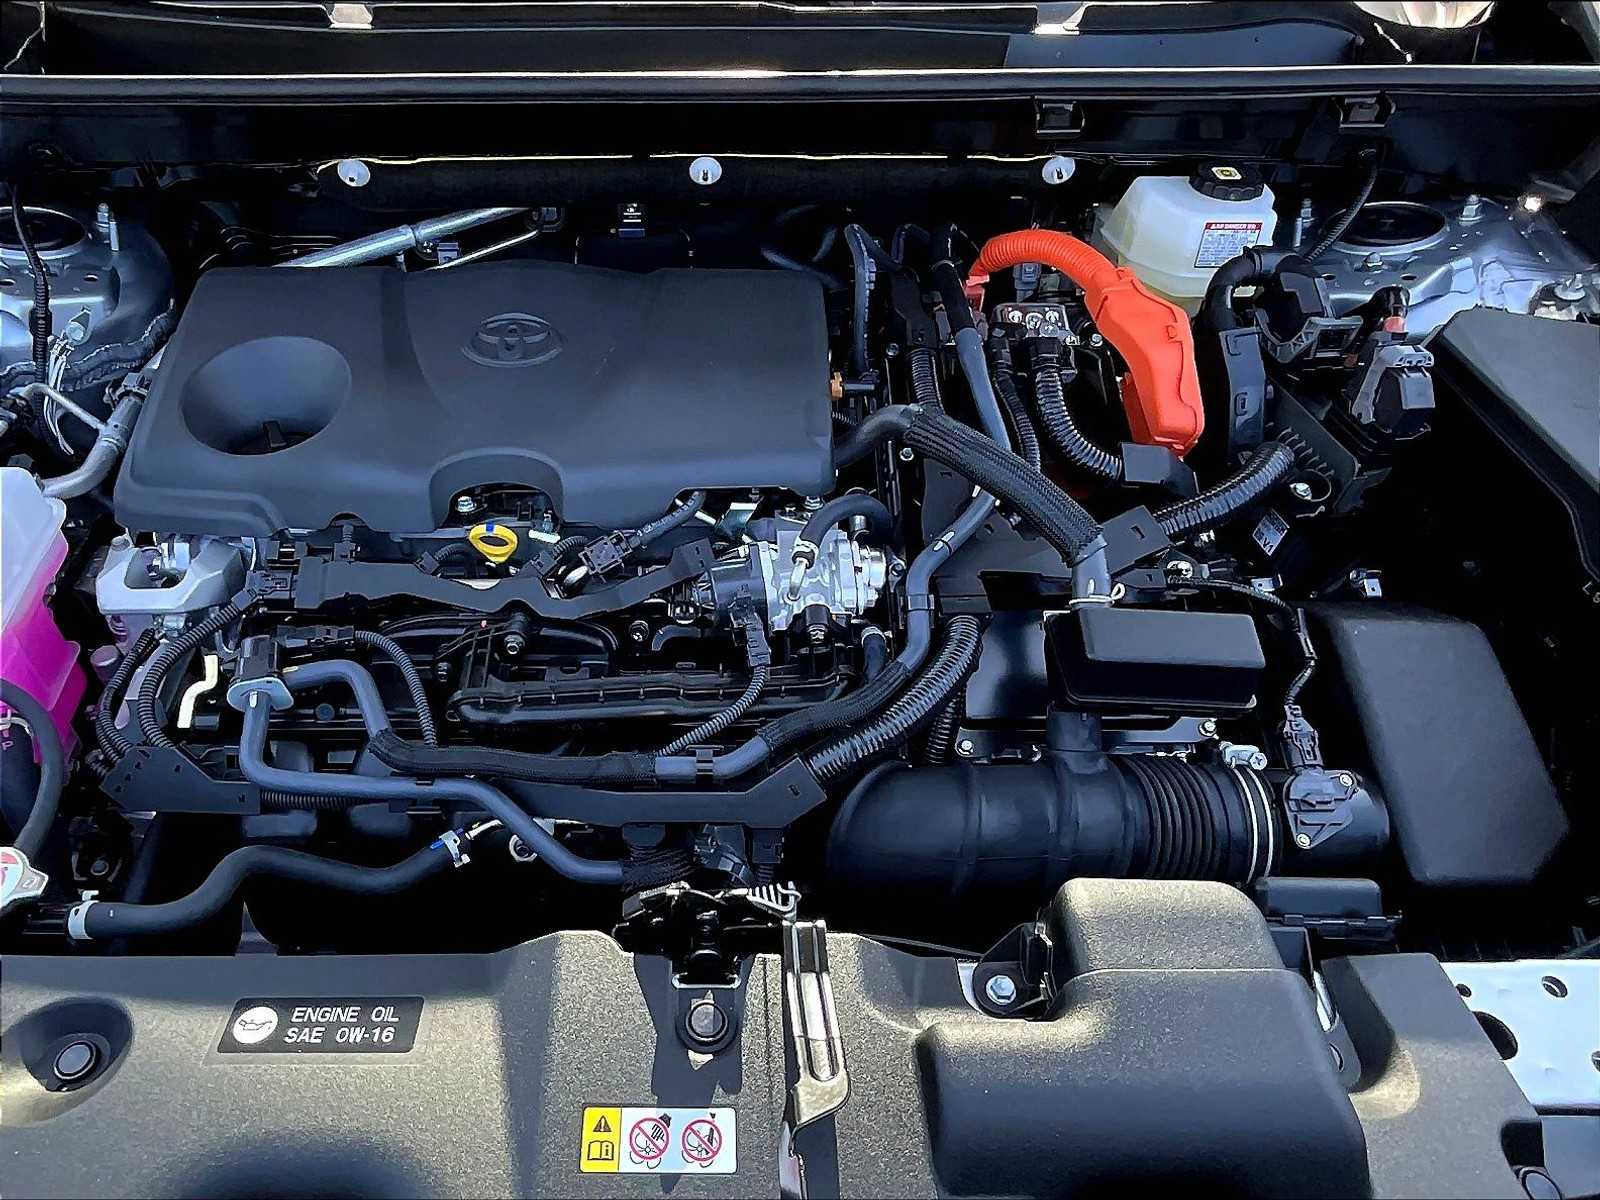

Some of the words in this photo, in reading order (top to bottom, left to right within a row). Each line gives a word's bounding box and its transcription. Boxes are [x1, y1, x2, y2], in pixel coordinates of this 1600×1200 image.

[291, 1006, 361, 1022] ENGINE
[371, 1006, 399, 1022] OIL
[283, 1026, 325, 1043] SAE
[335, 1026, 395, 1043] 0W-16
